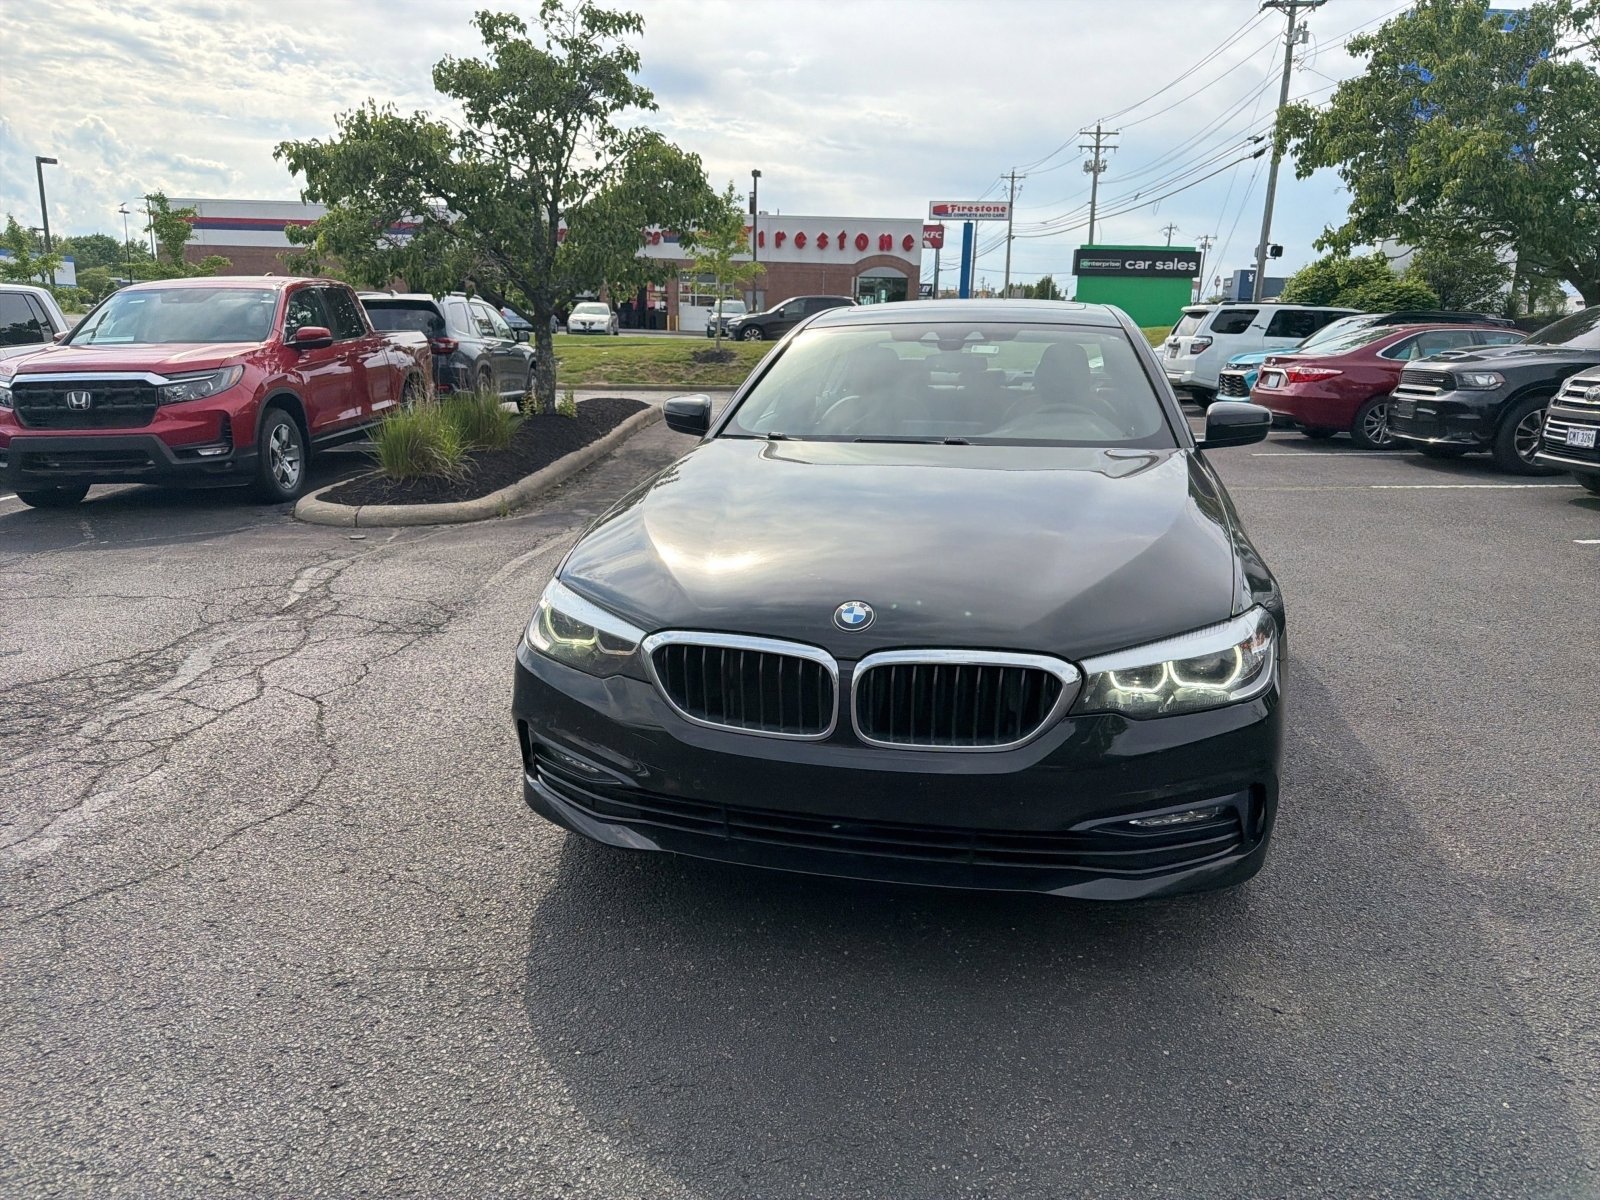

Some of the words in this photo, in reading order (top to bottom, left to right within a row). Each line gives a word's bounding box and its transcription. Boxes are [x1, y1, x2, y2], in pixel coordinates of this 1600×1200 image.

[949, 204, 1007, 213] Firestone
[923, 231, 942, 239] KFC
[1081, 260, 1120, 268] enterprise
[1125, 260, 1152, 270] car
[1155, 257, 1197, 271] sales
